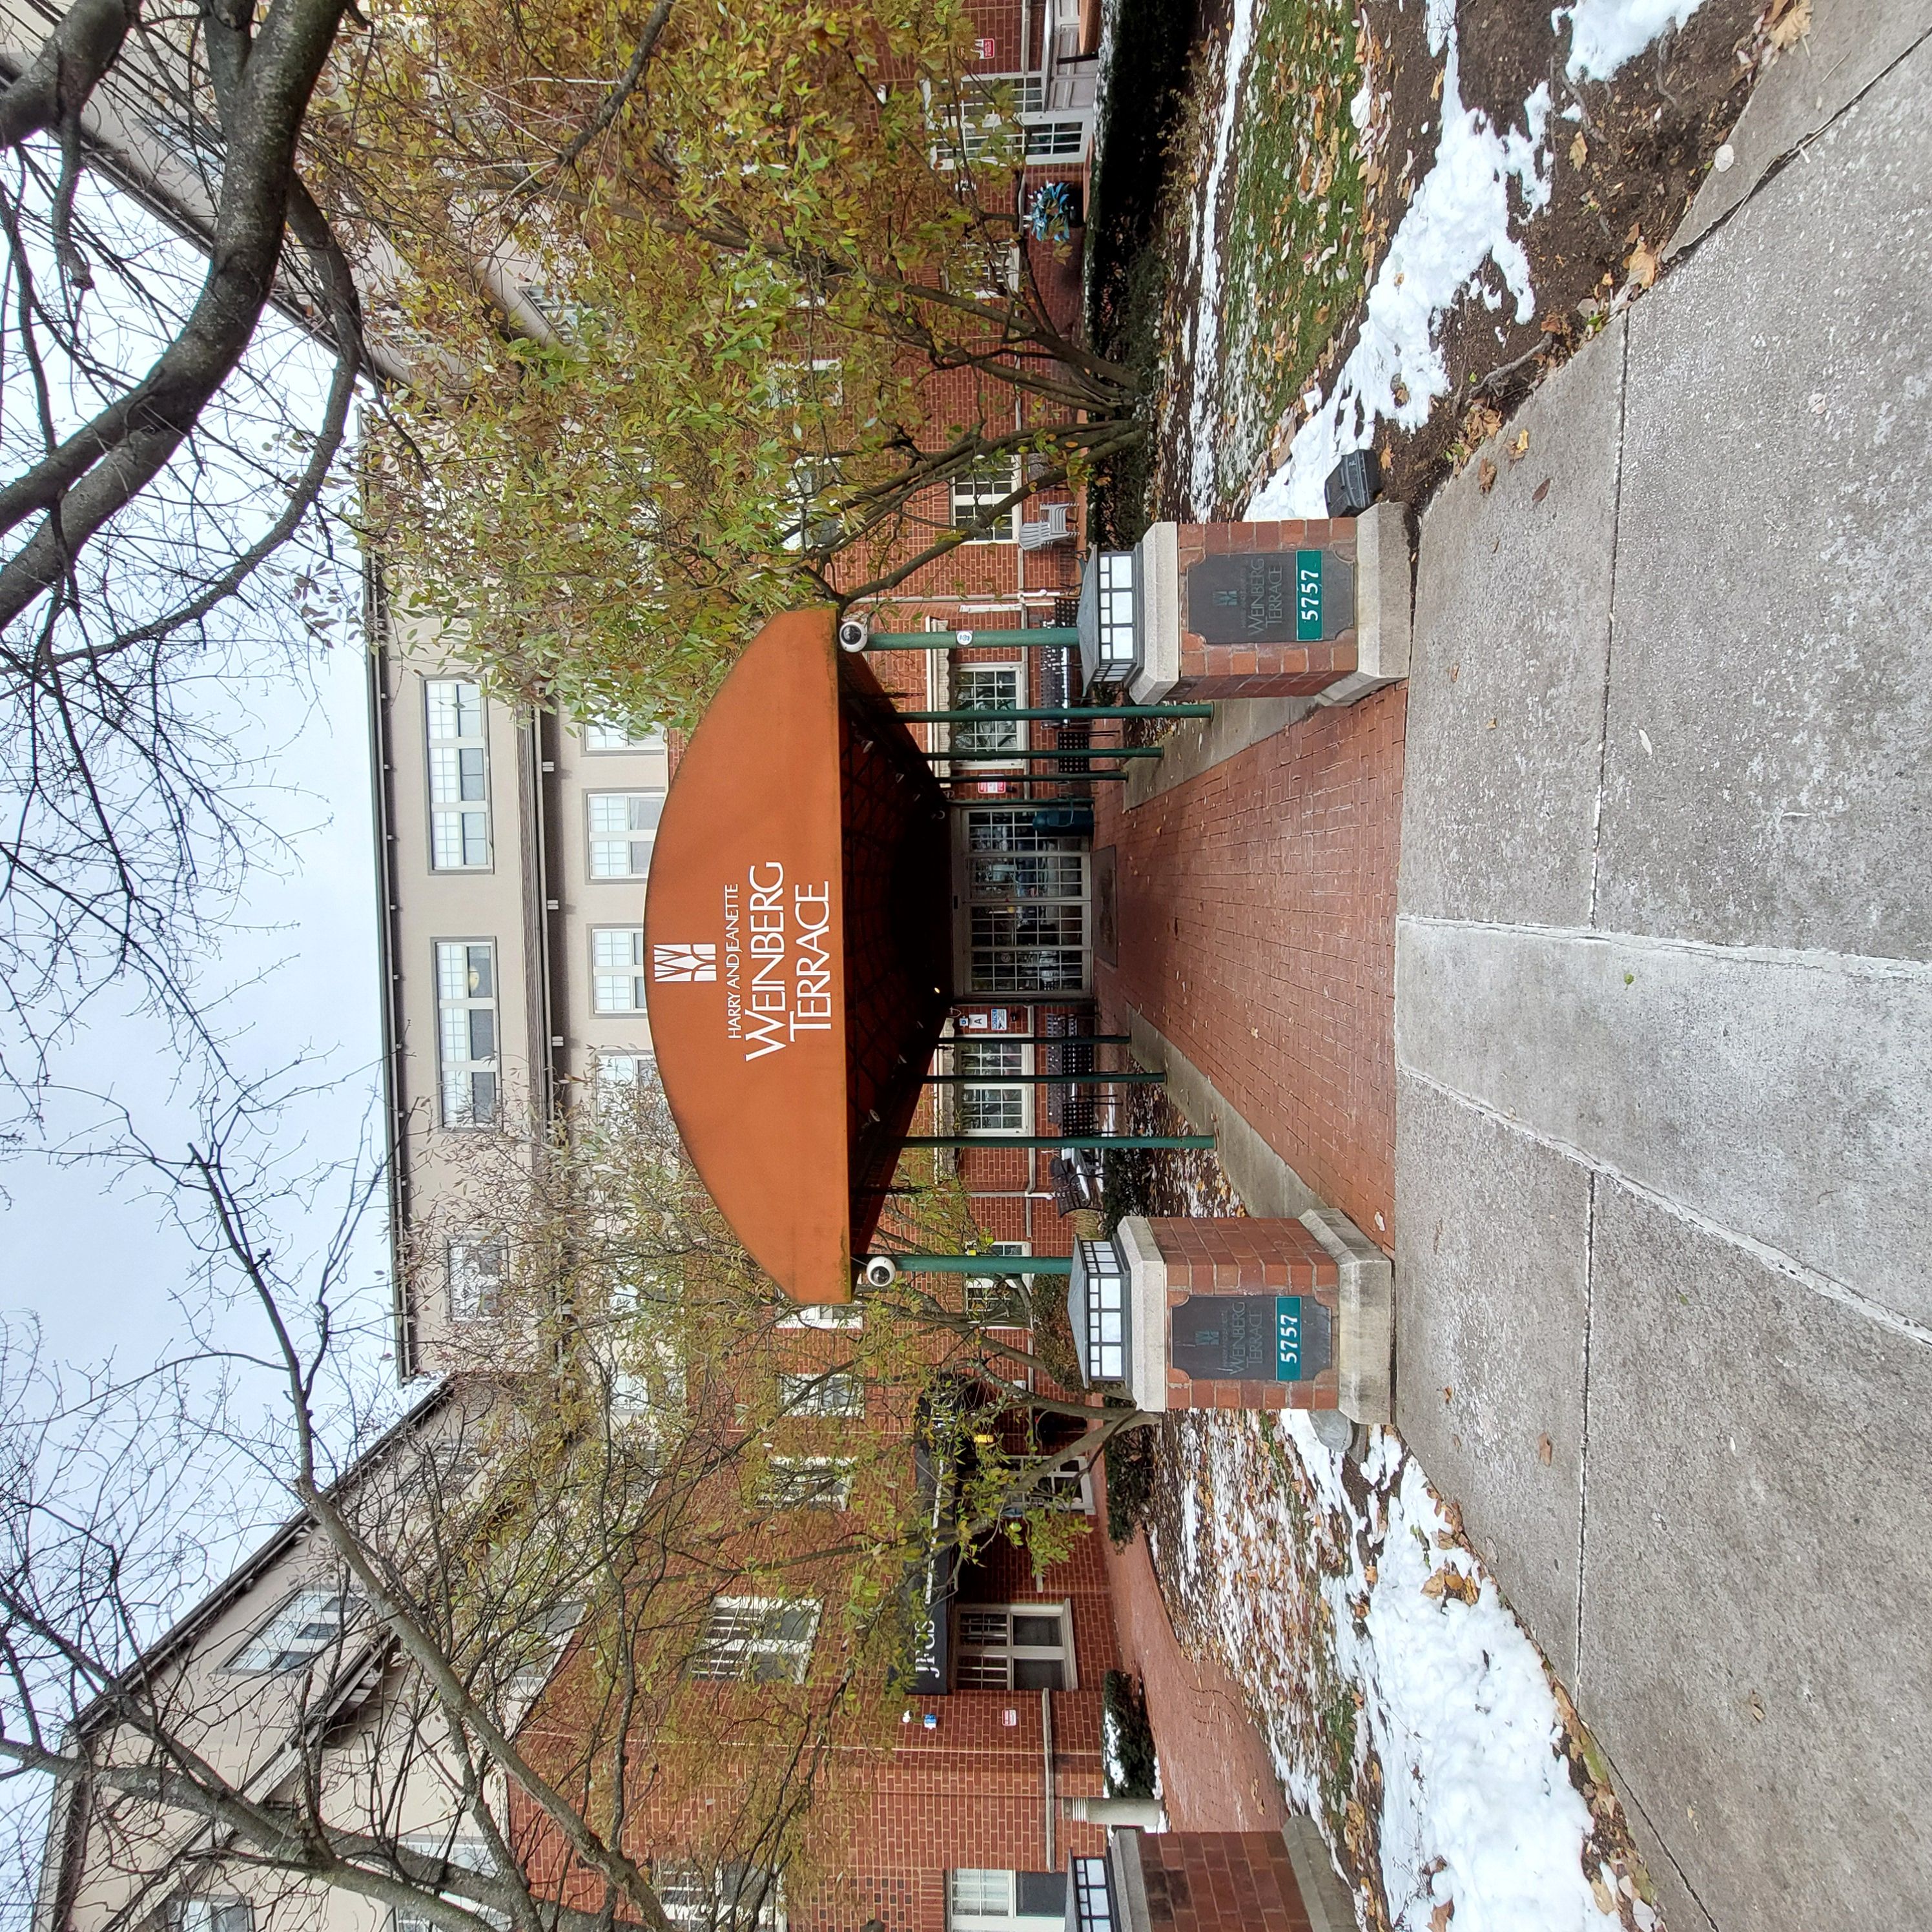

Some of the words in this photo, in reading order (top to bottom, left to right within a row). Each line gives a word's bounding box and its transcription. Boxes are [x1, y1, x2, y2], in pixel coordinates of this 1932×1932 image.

[1247, 557, 1265, 635] WEINBERG
[1266, 565, 1282, 628] TERRACE
[1300, 569, 1319, 621] 5757
[724, 883, 743, 952] JEANETTE
[725, 953, 741, 989] AND
[744, 861, 786, 1061] WEINBERG
[789, 880, 832, 1042] TERRACE
[727, 991, 742, 1038] HARRY
[1229, 1300, 1246, 1374] WEINBERG
[1246, 1309, 1263, 1368] TERRACE
[1280, 1313, 1298, 1363] 5757
